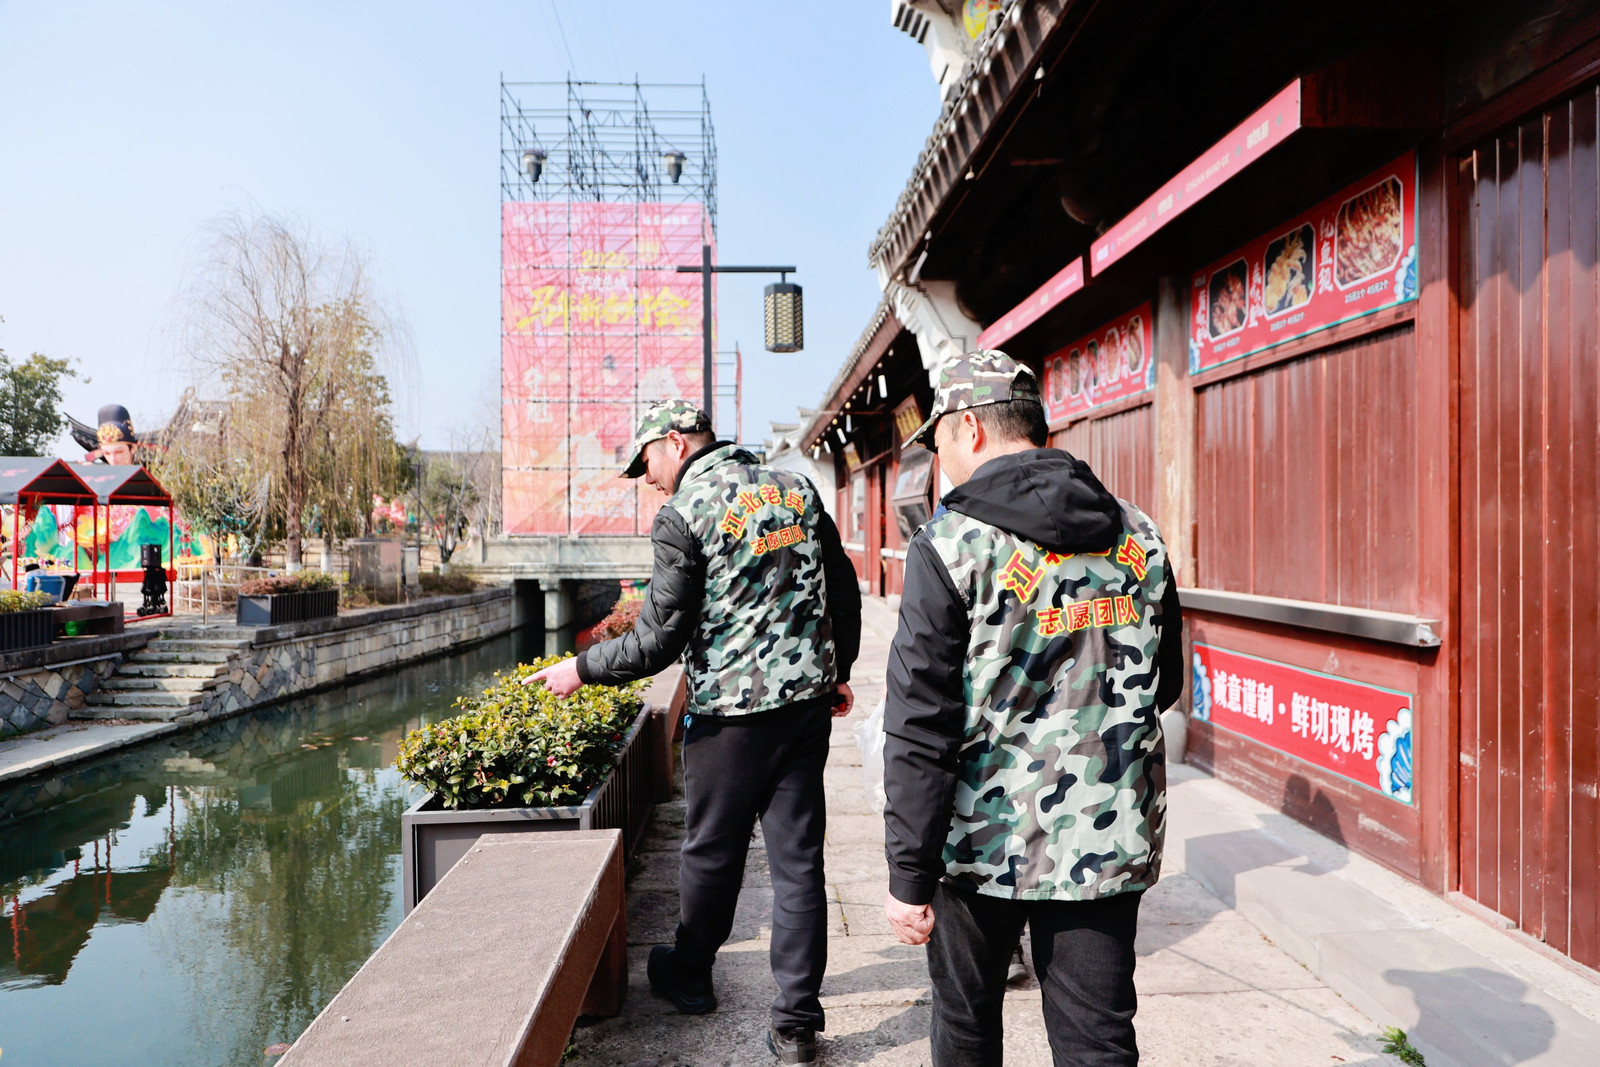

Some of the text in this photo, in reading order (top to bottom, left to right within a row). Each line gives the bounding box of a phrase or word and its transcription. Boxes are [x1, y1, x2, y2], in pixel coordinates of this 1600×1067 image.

[720, 484, 805, 540] 江北老兵
[750, 524, 806, 556] 志愿团队
[996, 534, 1148, 604] 江兵
[1036, 595, 1140, 637] 志愿团队
